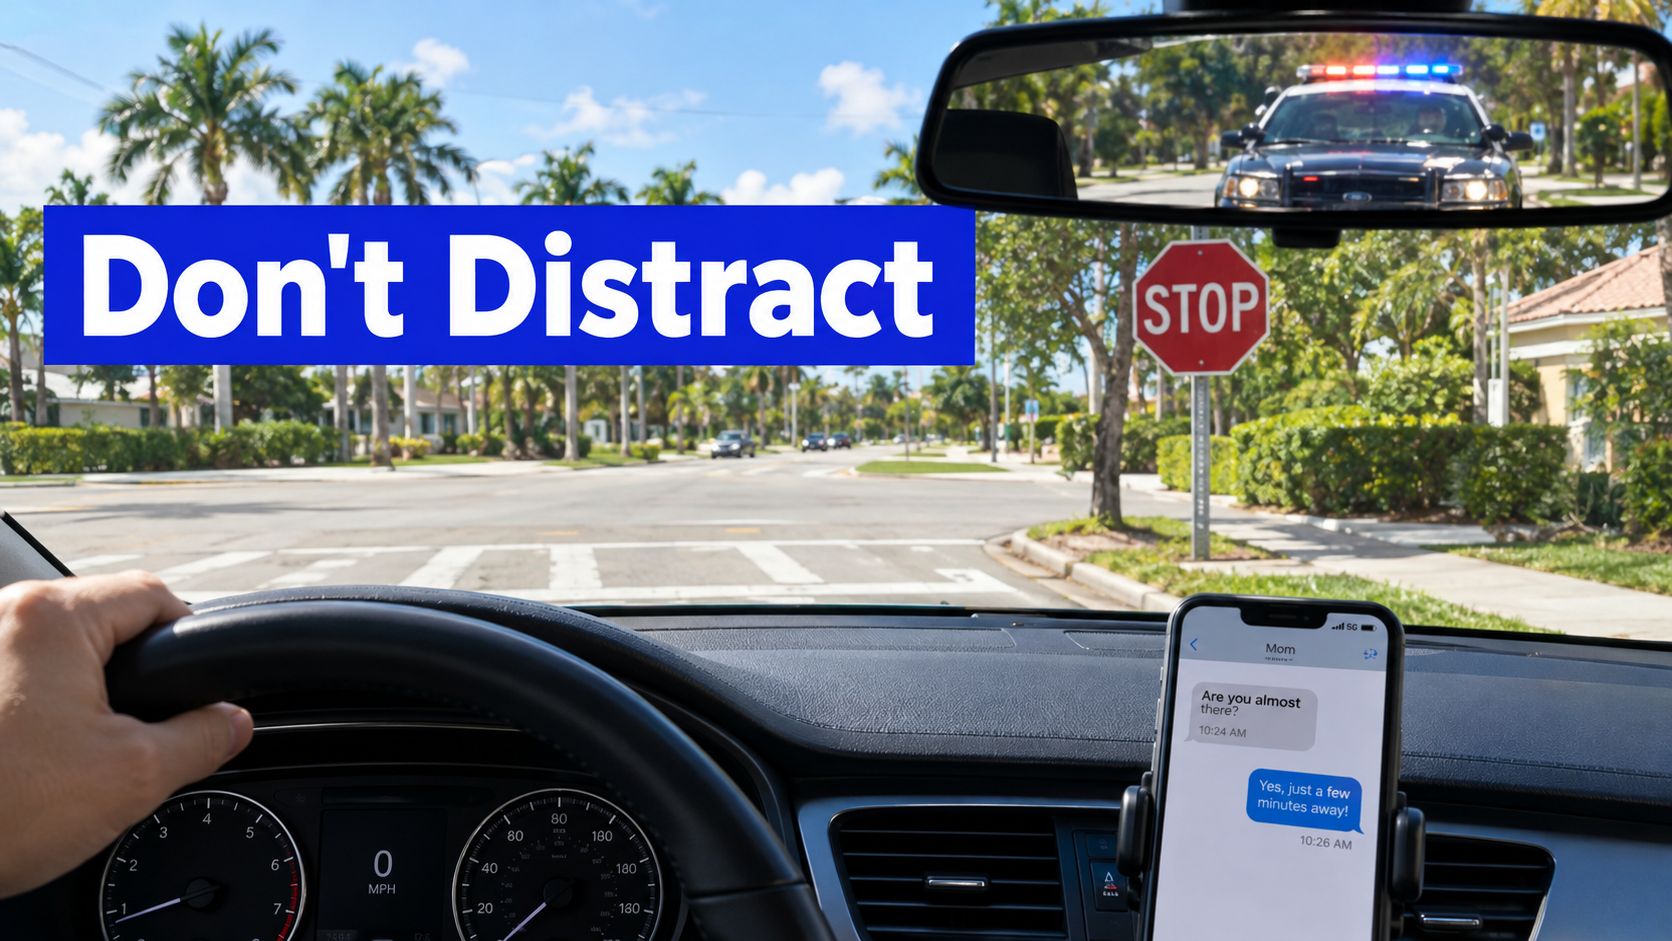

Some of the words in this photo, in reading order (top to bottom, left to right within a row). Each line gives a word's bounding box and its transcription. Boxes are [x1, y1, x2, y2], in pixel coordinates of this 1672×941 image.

[1143, 282, 1259, 335] STOP
[1266, 644, 1295, 654] Mom
[1202, 691, 1224, 702] Are
[1228, 695, 1251, 705] you
[1256, 695, 1300, 708] almost
[1201, 703, 1238, 716] there?
[1200, 726, 1226, 736] 10:24
[1230, 728, 1246, 737] AM
[1260, 780, 1284, 795] Yes,
[1287, 782, 1312, 796] just
[1316, 788, 1323, 796] a
[1327, 786, 1350, 799] few
[1258, 798, 1307, 812] minutes
[1311, 805, 1348, 818] away!
[203, 813, 212, 825] 4
[551, 813, 568, 825] 80
[160, 826, 168, 839] 3
[246, 827, 255, 839] 5
[1301, 836, 1330, 847] 10:26
[1334, 840, 1352, 850] AM
[130, 859, 138, 872] 2
[271, 859, 280, 871] 6
[374, 850, 392, 877] 0
[482, 863, 498, 874] 40
[369, 884, 395, 894] MPH
[120, 902, 128, 915] 1
[274, 903, 282, 915] 7
[478, 903, 494, 914] 20
